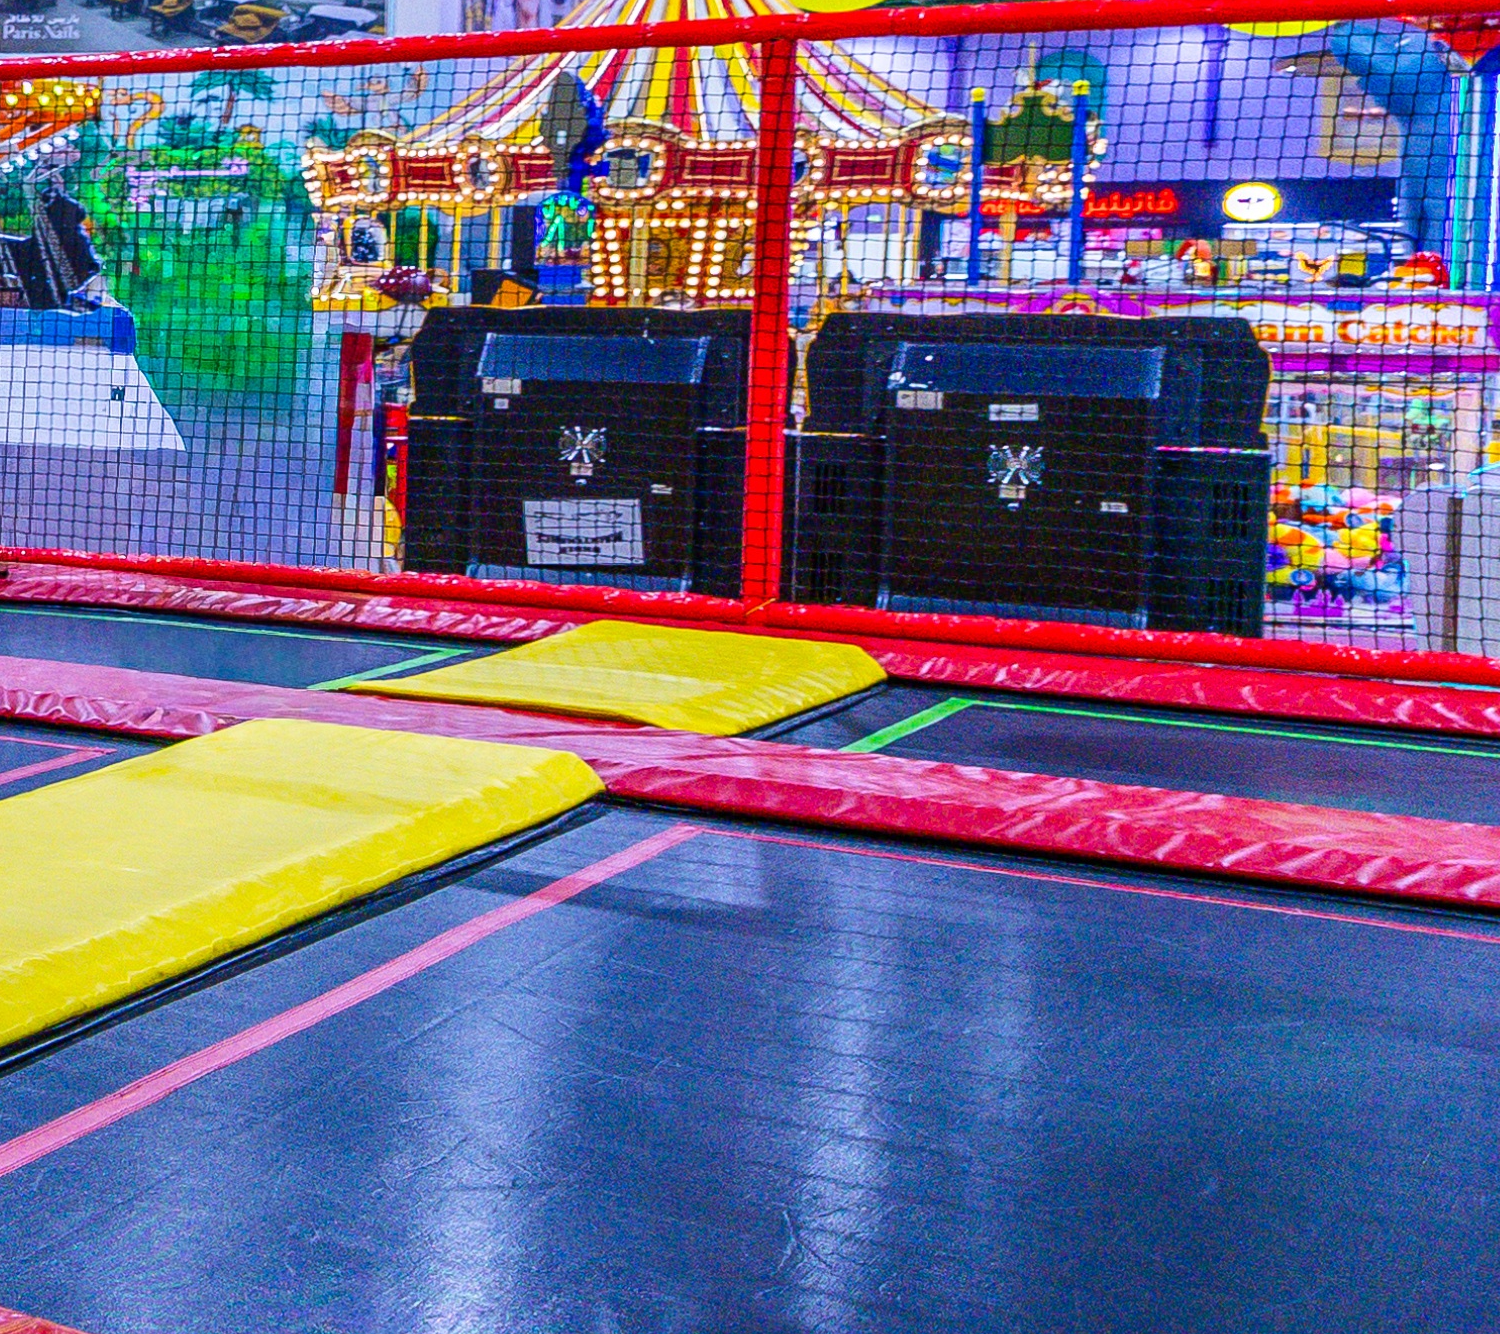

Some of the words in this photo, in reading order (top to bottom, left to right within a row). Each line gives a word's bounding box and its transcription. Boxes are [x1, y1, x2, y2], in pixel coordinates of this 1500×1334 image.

[2, 24, 41, 40] Paris
[41, 24, 80, 40] Nails
[1335, 319, 1480, 344] Catcher
